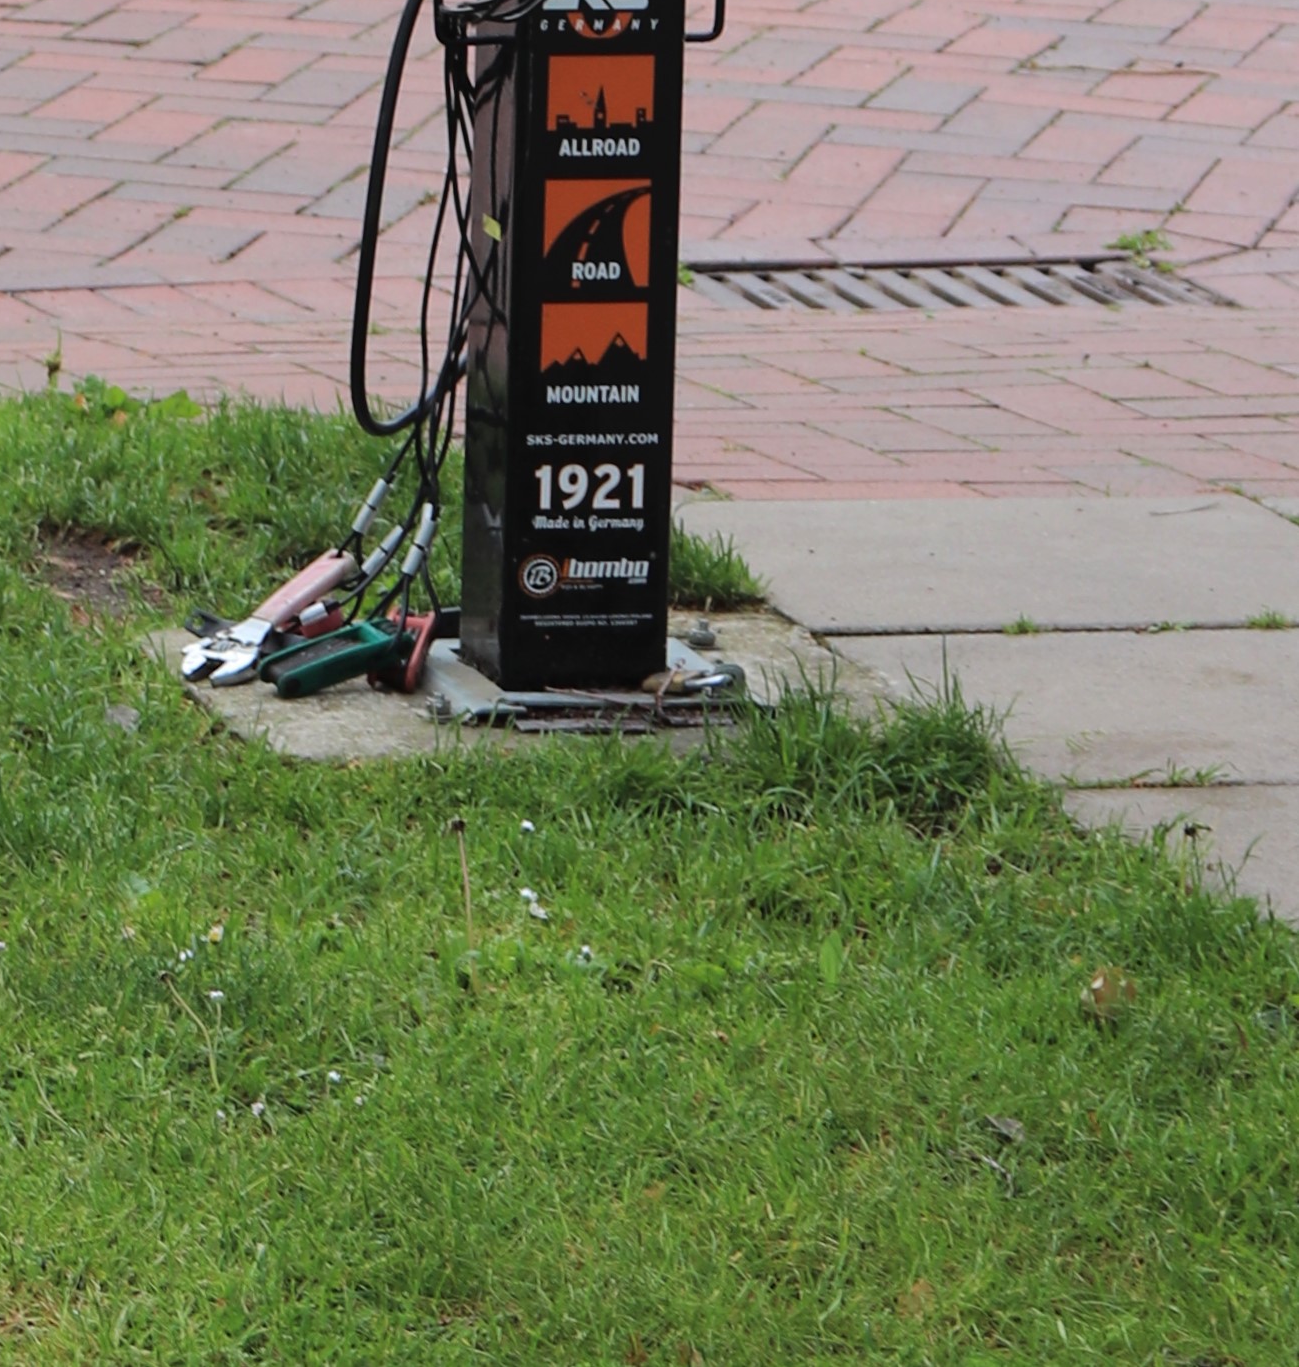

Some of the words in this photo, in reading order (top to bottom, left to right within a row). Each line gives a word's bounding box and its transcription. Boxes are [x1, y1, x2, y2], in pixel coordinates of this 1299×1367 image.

[539, 18, 659, 31] GERMANY
[558, 138, 641, 157] ALLROAD
[572, 262, 621, 280] ROAD
[546, 385, 640, 404] MOUNTAIN
[526, 433, 658, 446] SKS-GERMANY.COM
[534, 463, 645, 510] 1921
[532, 515, 570, 529] Made
[572, 515, 586, 529] in
[588, 515, 644, 531] Germany
